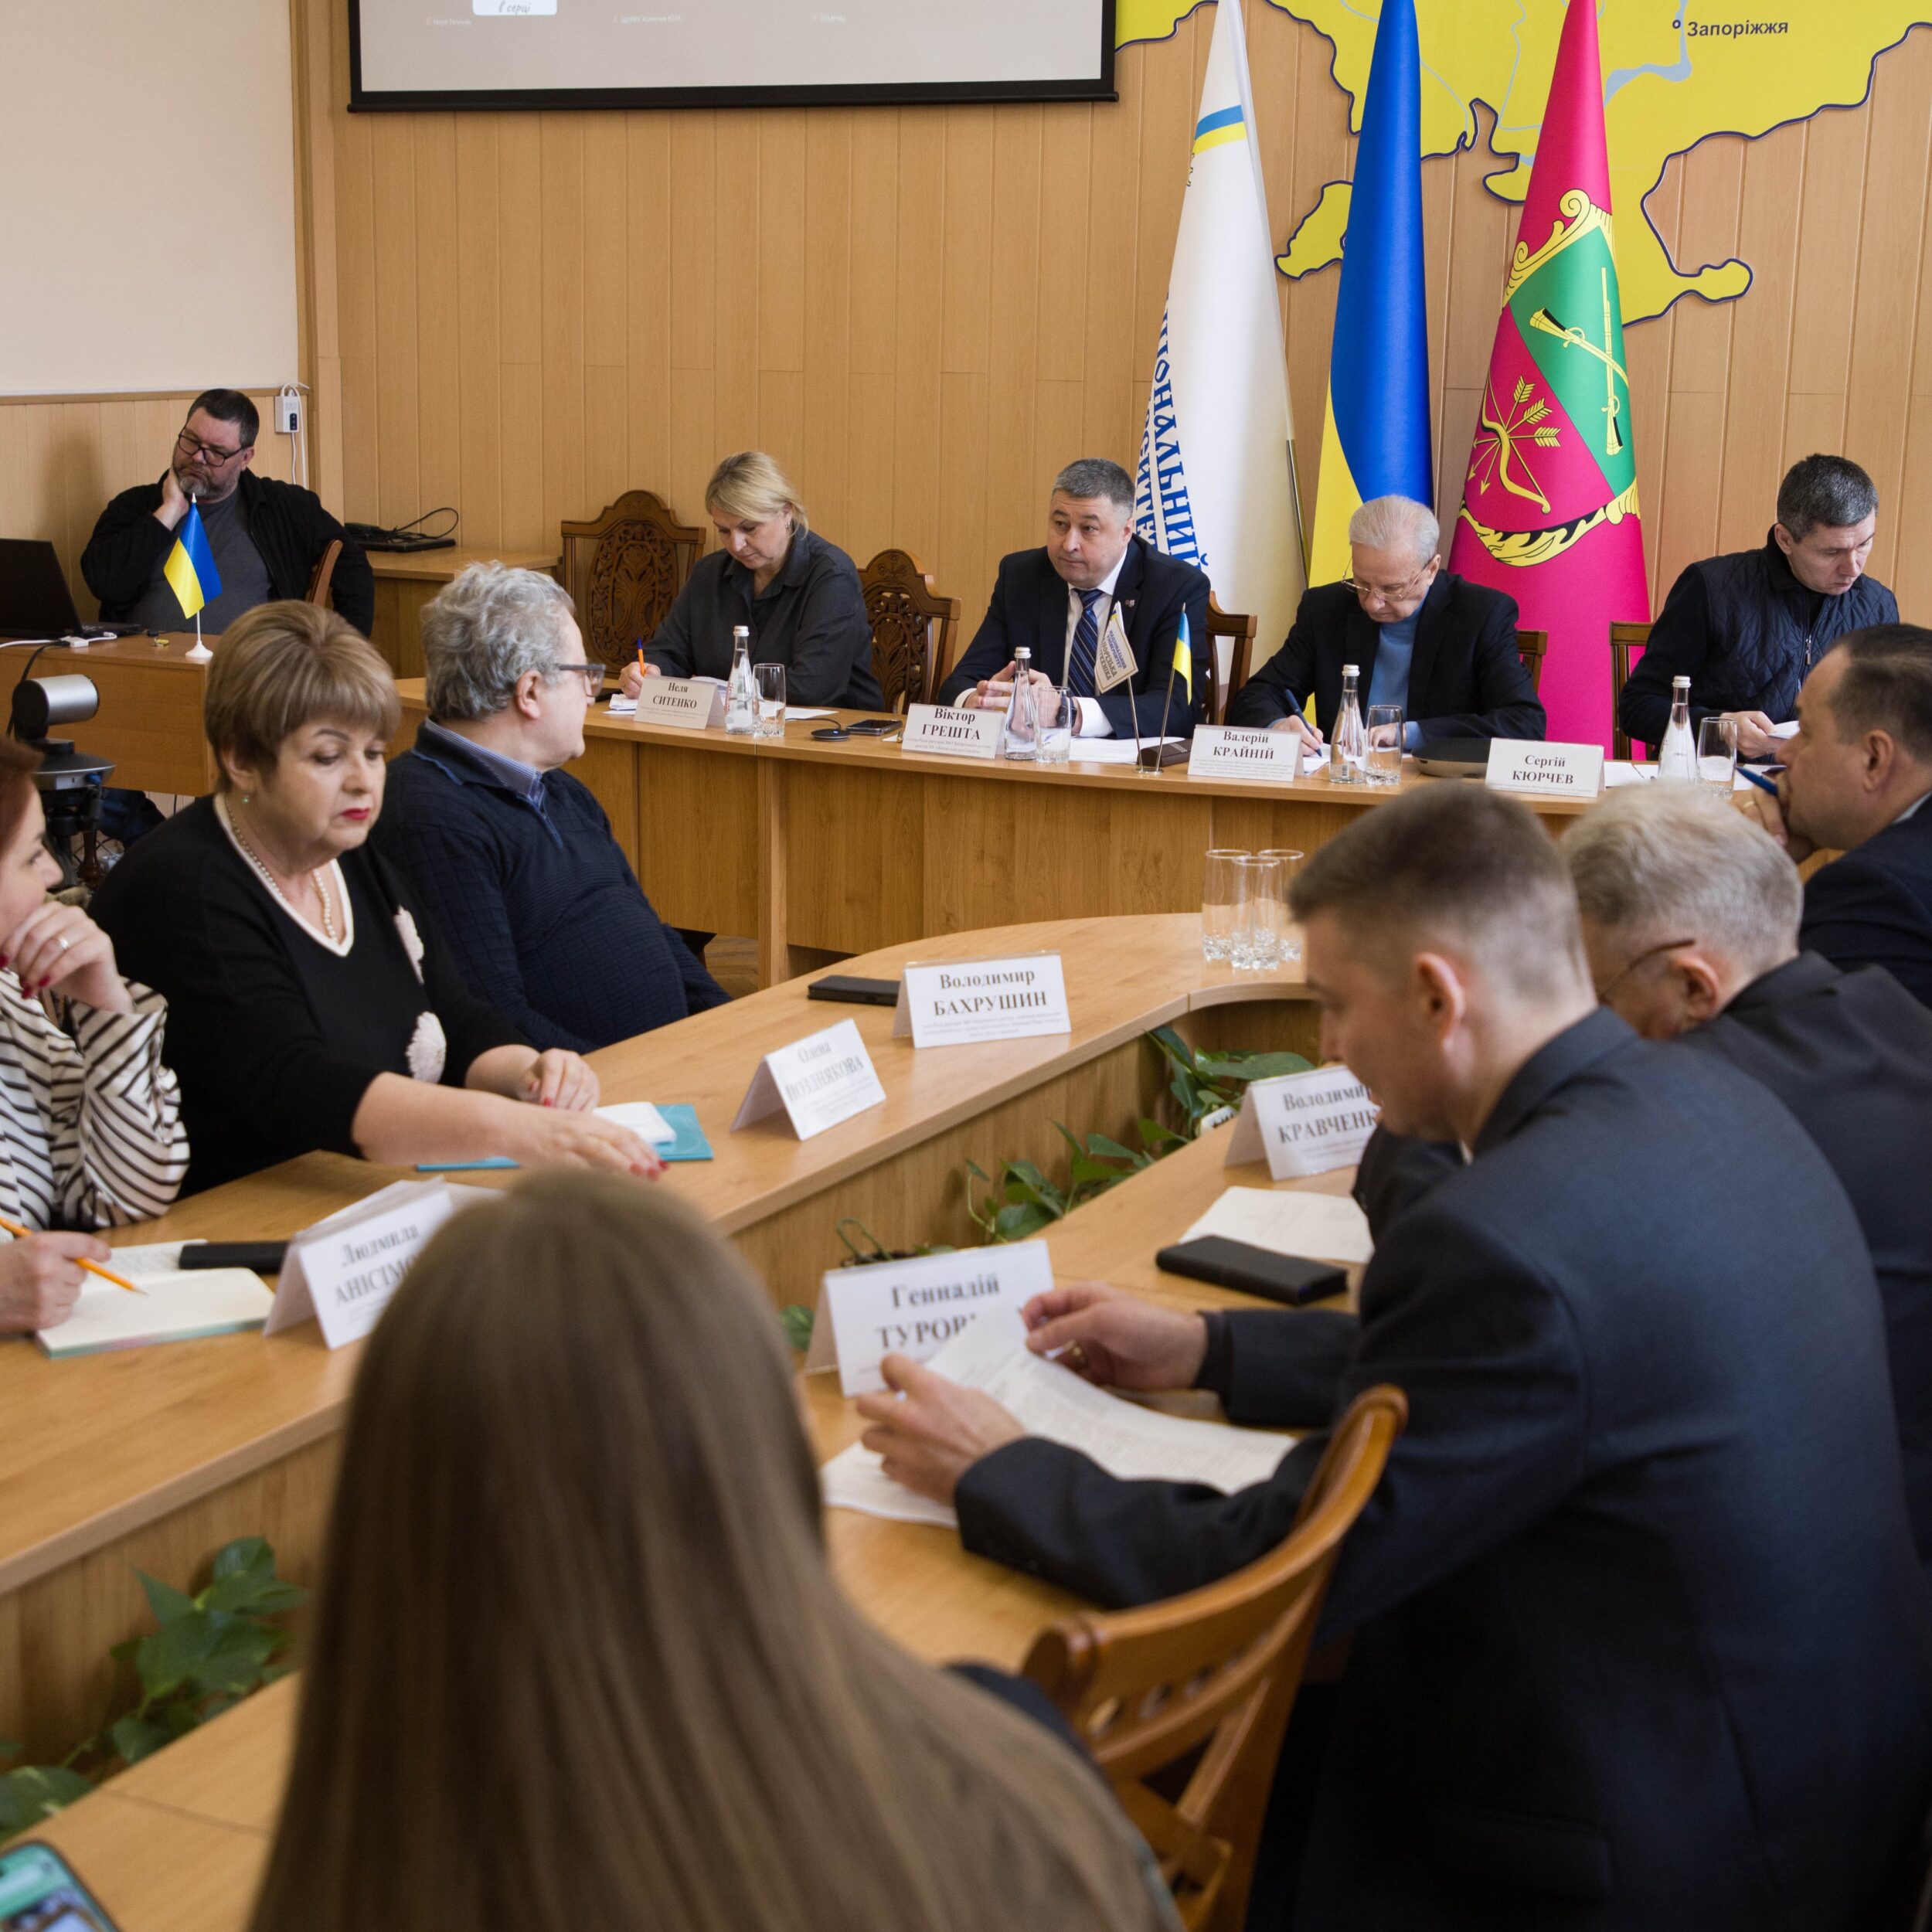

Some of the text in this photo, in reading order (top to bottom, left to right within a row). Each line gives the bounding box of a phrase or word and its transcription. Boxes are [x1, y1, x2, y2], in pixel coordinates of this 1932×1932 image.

[1687, 19, 1788, 39] Запоріжжя
[668, 682, 689, 693] Неля
[652, 695, 697, 709] СИТЕНКО
[934, 707, 976, 725] Віктор
[921, 723, 981, 740] ГРЕШТА
[1223, 730, 1269, 745] Валерій
[1213, 746, 1274, 760] КРАЙНІЙ
[1524, 754, 1566, 768] Сергій
[1512, 770, 1573, 784] КЮРЧЕВ
[939, 970, 1036, 990] Володимир
[933, 991, 1047, 1016] БАХРУШИН
[798, 1041, 832, 1063] Олена
[1277, 1108, 1378, 1144] КРАВЧЕНК
[341, 1223, 420, 1267] Людмила
[891, 1273, 1001, 1308] Геннадій
